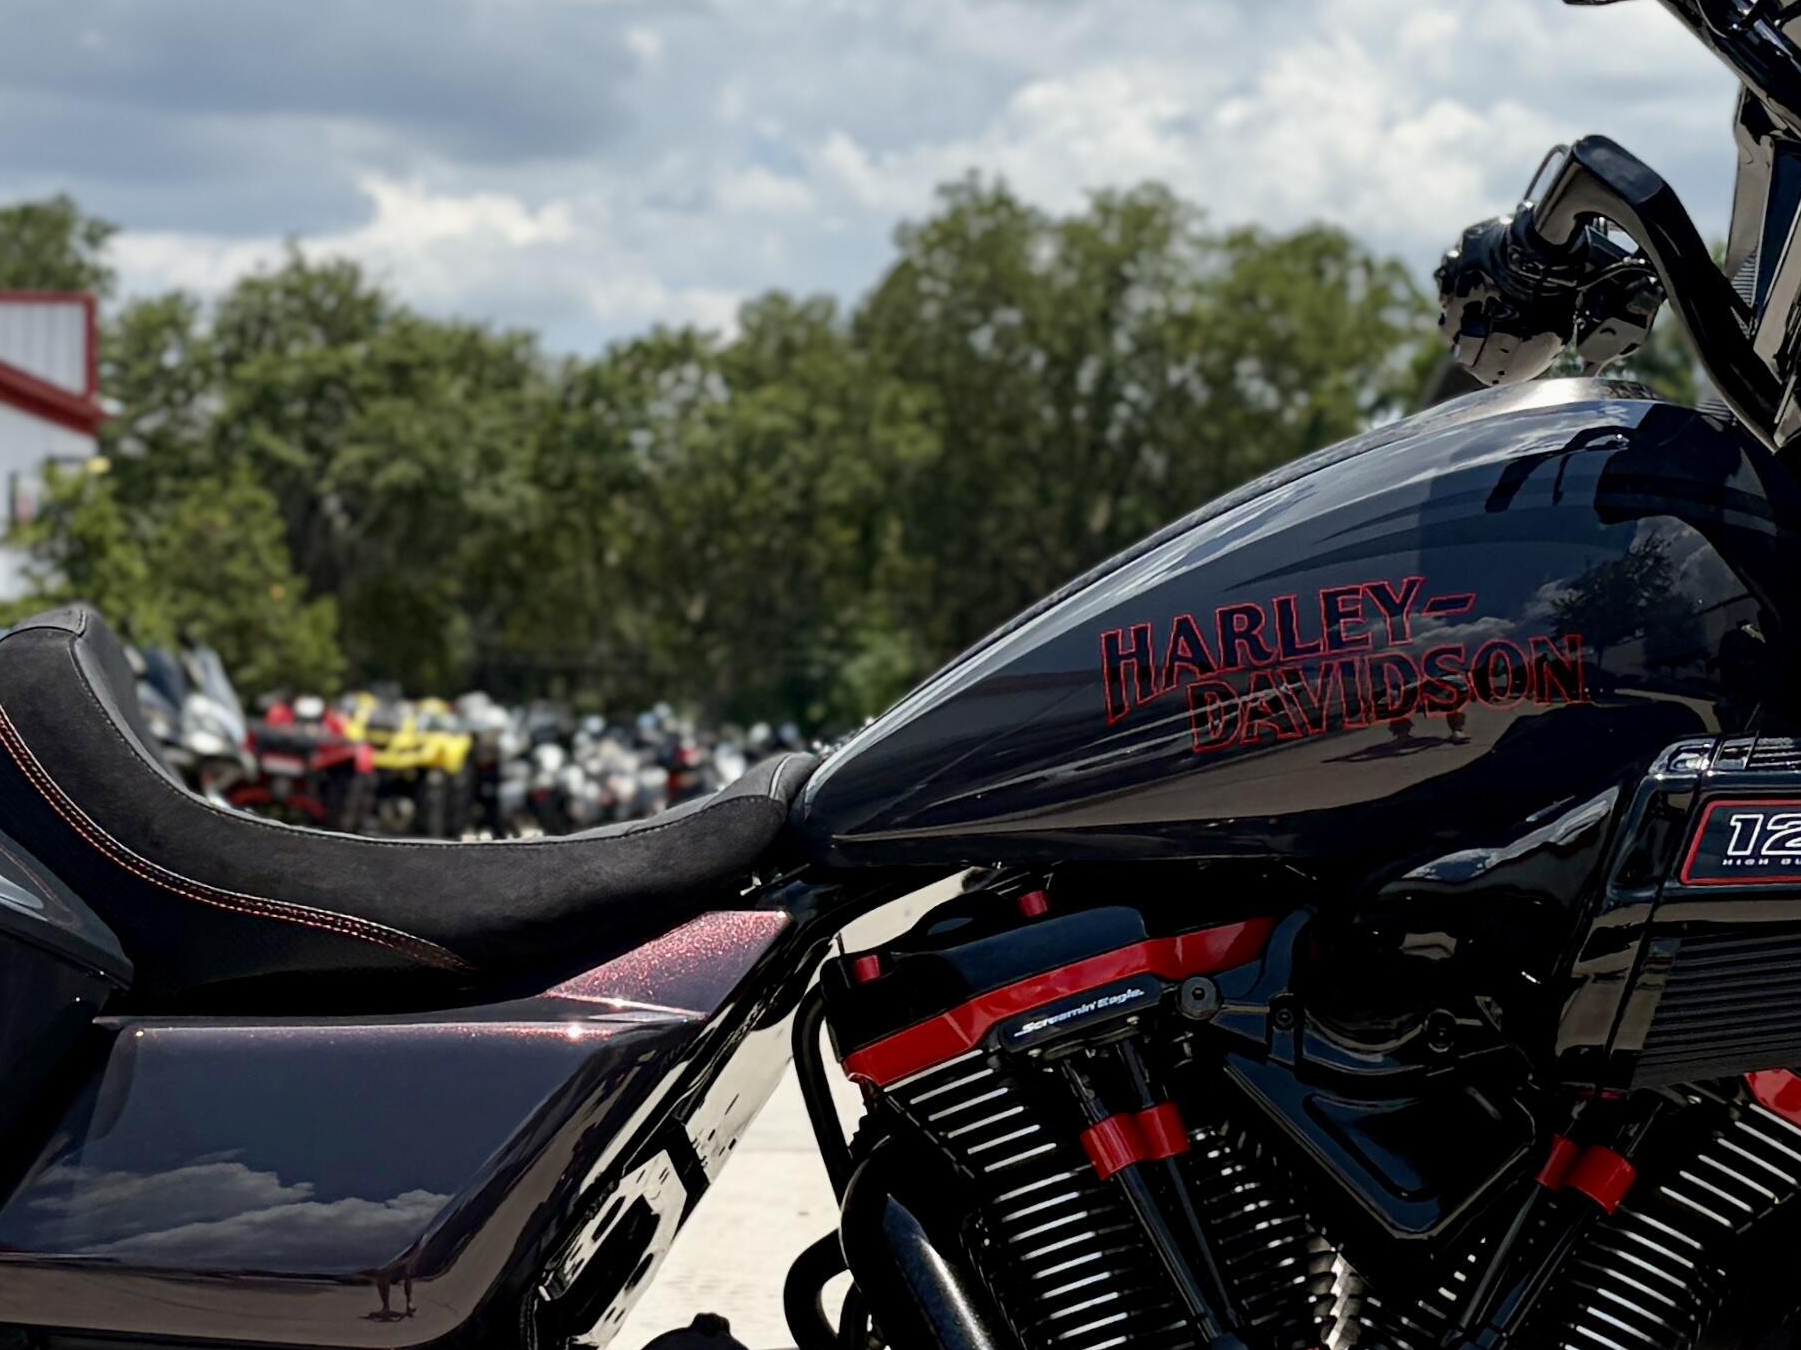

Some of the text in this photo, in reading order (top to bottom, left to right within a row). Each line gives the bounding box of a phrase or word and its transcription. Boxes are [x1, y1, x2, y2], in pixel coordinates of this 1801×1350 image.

[1185, 633, 1590, 753] DAVIDSON
[1722, 857, 1769, 866] HIGH
[1096, 988, 1146, 1008] Eagle
